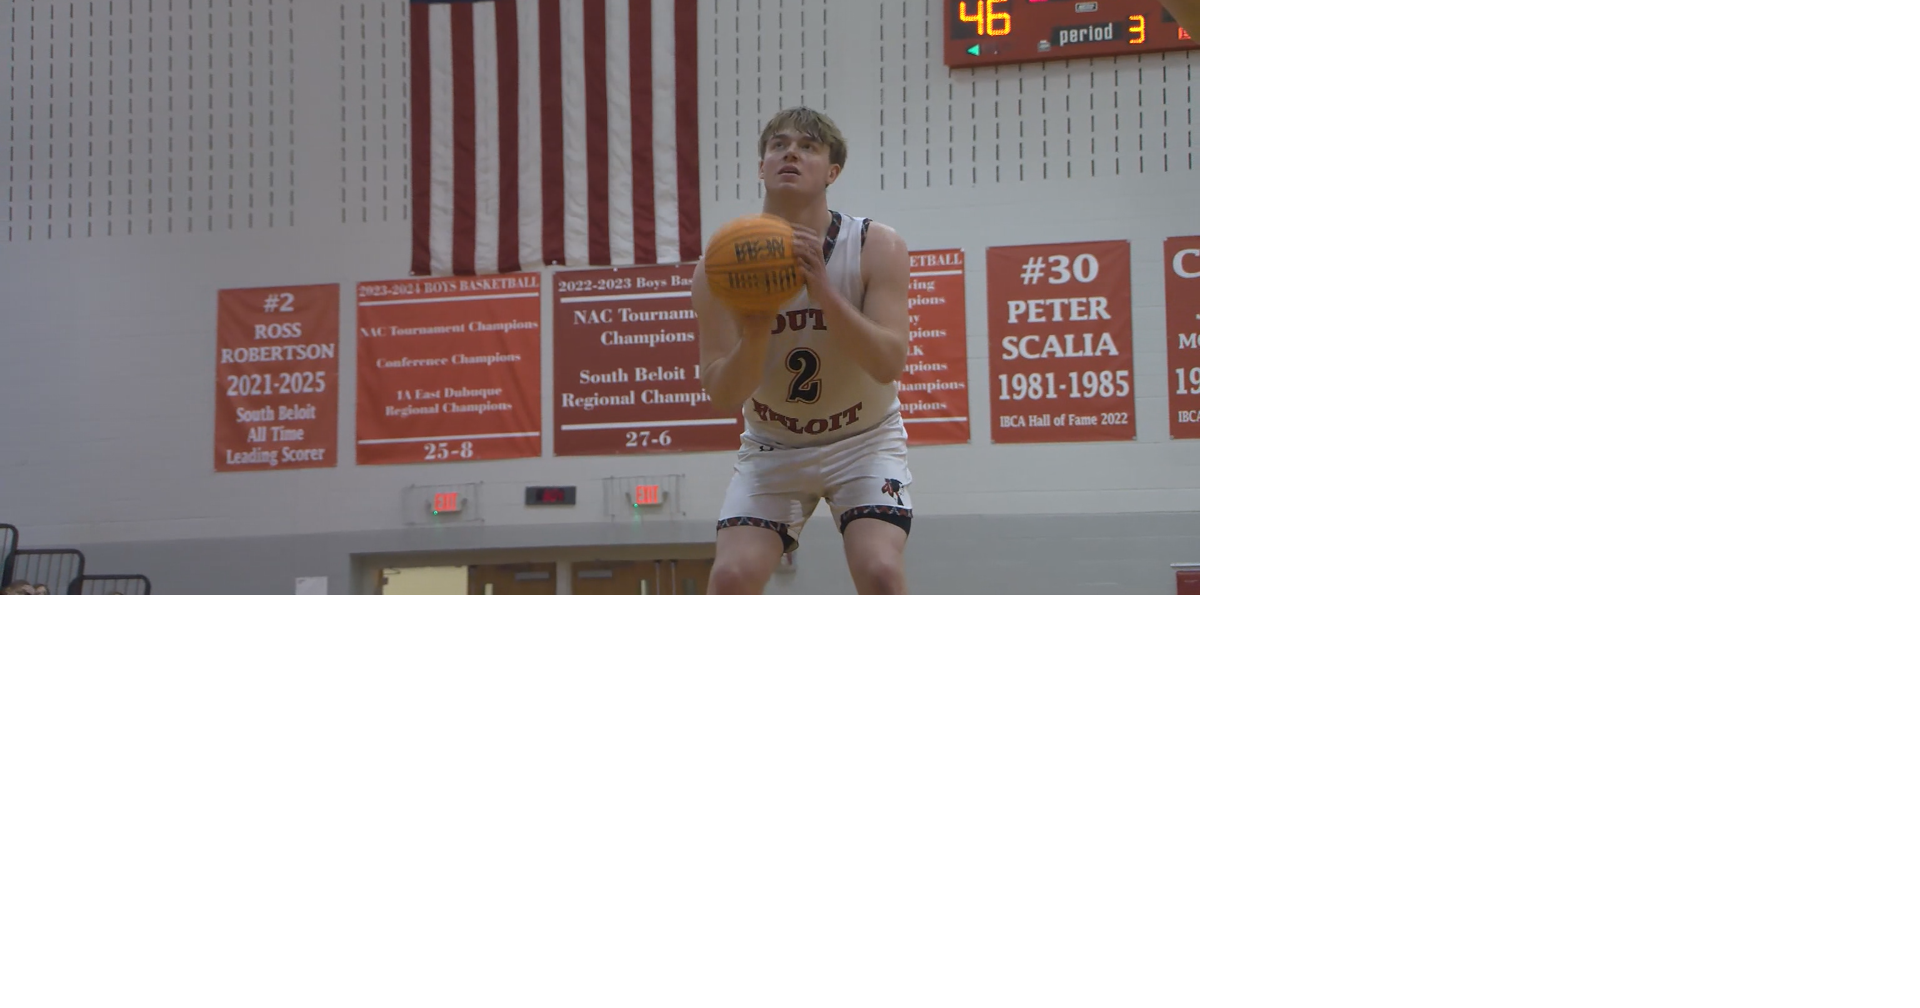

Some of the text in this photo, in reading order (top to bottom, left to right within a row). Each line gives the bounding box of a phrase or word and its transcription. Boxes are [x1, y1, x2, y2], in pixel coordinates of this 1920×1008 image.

[959, 0, 1010, 36] 46
[1060, 22, 1113, 47] period
[1128, 14, 1145, 44] 3
[1020, 253, 1099, 285] #30
[1172, 248, 1200, 278] C
[359, 276, 539, 297] 2023-2024 BOYS BASKETBALL
[558, 278, 632, 292] 2022-2023
[636, 277, 667, 290] Boys
[263, 293, 295, 313] #2
[1007, 296, 1111, 323] PETER
[573, 309, 612, 325] NAC
[254, 322, 302, 340] ROSS
[360, 319, 538, 338] NAC Tournament Champions
[600, 329, 695, 348] Champions
[1001, 332, 1119, 360] SCALIA
[1178, 333, 1200, 349] M
[221, 343, 335, 364] ROBERTSON
[376, 352, 521, 369] Conference Champions
[226, 371, 325, 396] 2021-2025
[579, 368, 629, 384] South
[634, 366, 686, 382] Beloit
[784, 346, 822, 404] 2
[415, 389, 441, 400] East
[444, 387, 502, 400] Dubuque
[998, 370, 1130, 400] 1981-1985
[385, 401, 512, 417] Regional Champions
[561, 390, 635, 410] Regional
[236, 403, 316, 422] South Beloit
[1000, 412, 1128, 427] IBCA Hall of Fame 2022
[247, 425, 304, 443] All Time
[625, 430, 672, 447] 27-6
[226, 446, 325, 466] Leading Scorer
[424, 441, 474, 460] 25-8
[635, 484, 659, 504] EXIT
